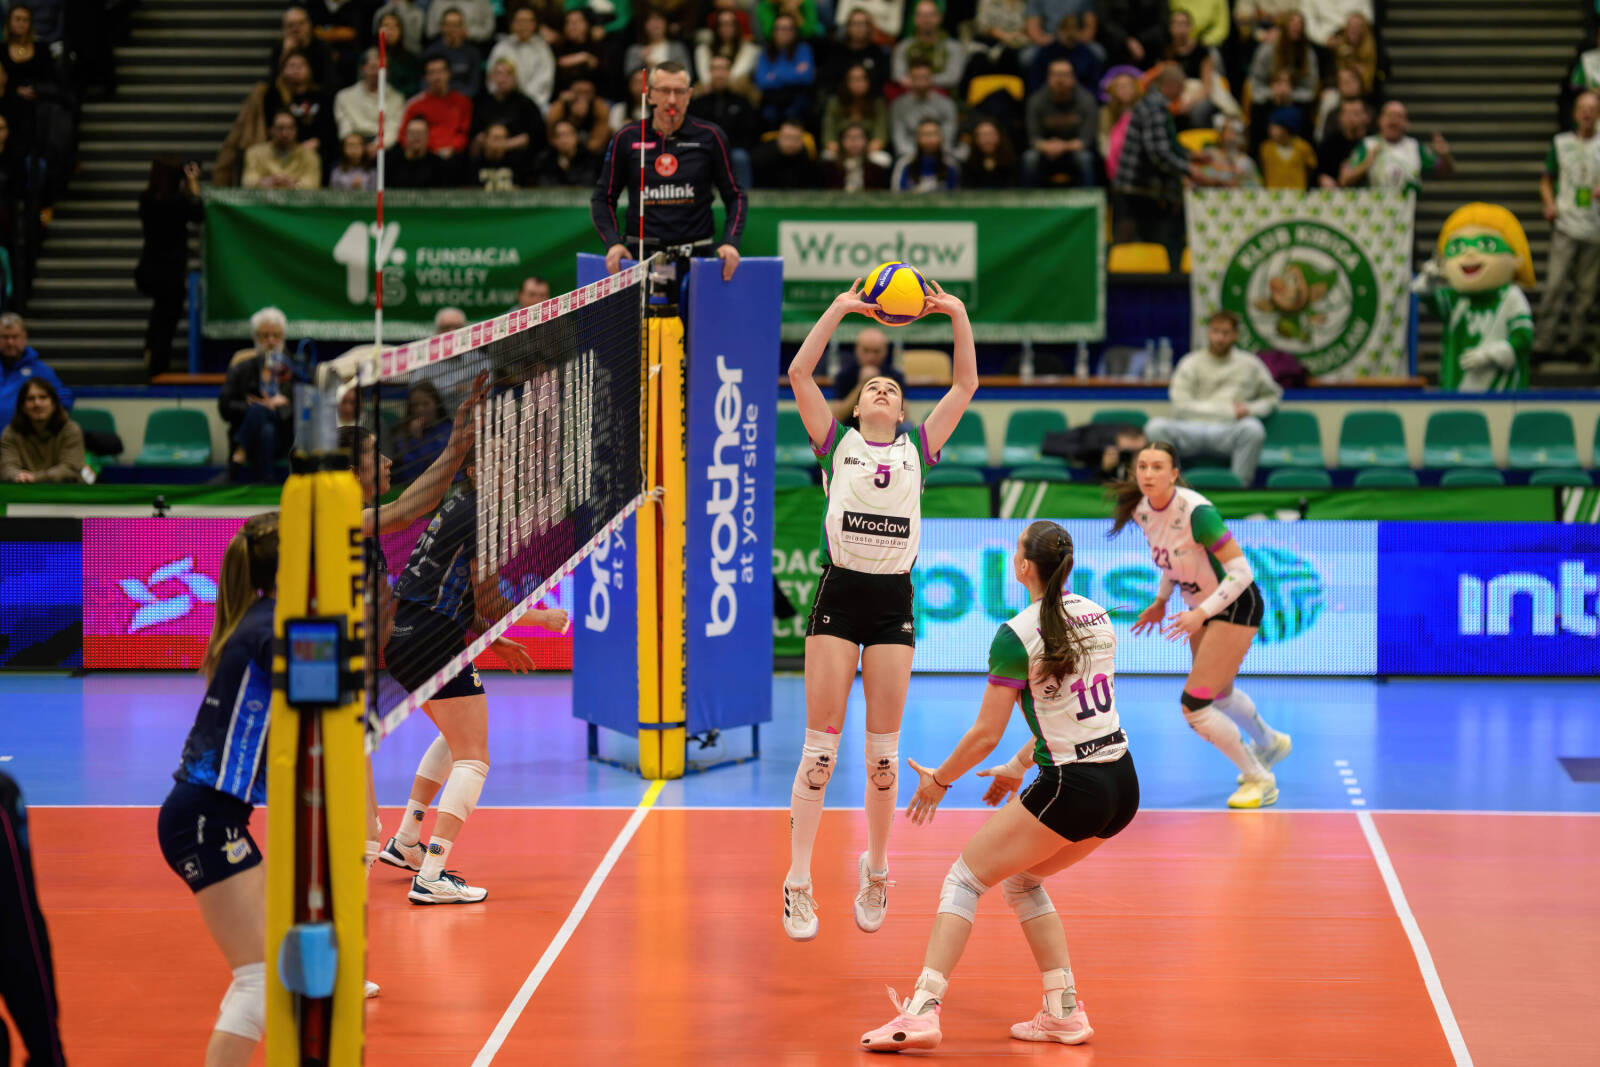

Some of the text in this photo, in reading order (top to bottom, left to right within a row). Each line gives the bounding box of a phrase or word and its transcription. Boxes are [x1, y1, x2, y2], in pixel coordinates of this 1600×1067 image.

[416, 247, 520, 266] FUNDACJA
[792, 231, 966, 267] Wrocław
[415, 268, 488, 285] VOLLEY
[873, 463, 891, 489] 5
[705, 355, 743, 637] brother
[741, 403, 758, 584] at your side
[847, 514, 908, 534] Wrocław
[612, 558, 624, 590] at
[1458, 559, 1600, 637] int
[1070, 673, 1112, 721] 10
